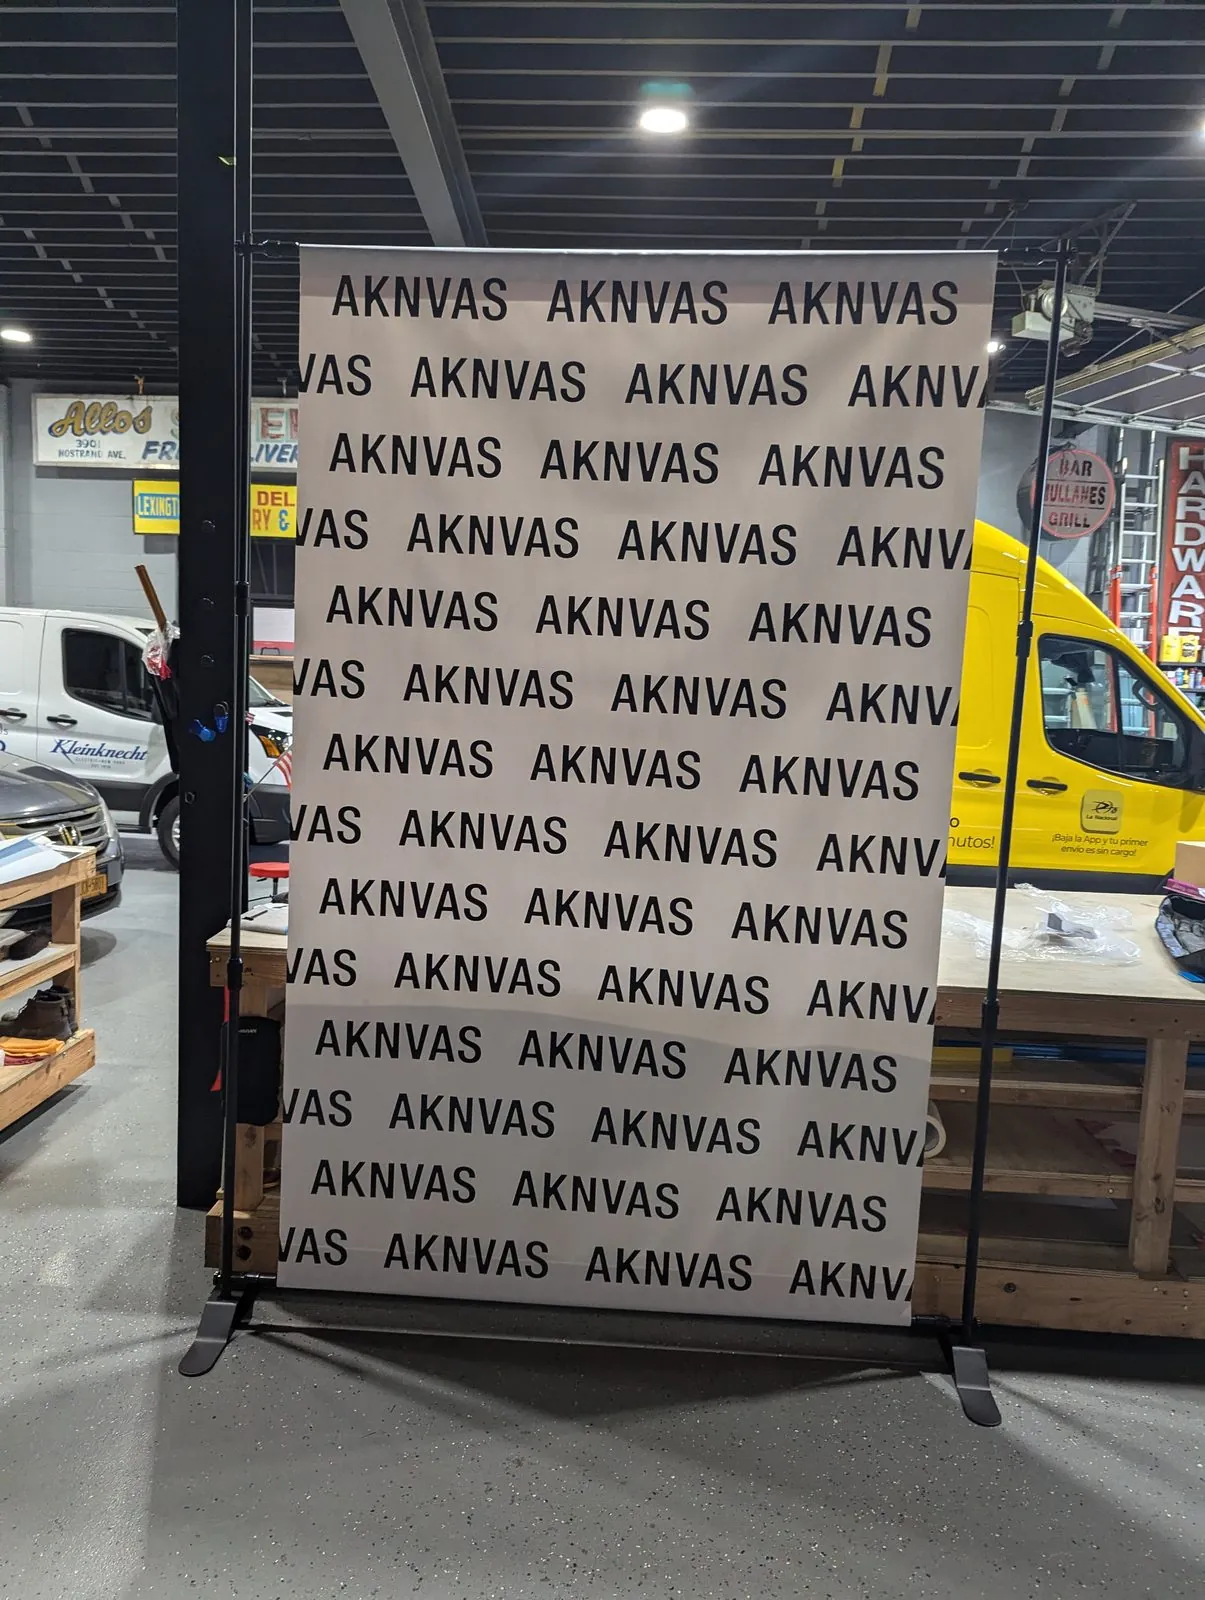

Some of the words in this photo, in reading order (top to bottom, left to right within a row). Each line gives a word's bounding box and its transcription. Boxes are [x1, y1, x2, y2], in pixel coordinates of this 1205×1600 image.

[332, 275, 507, 320] AKNVAS
[547, 280, 727, 324] AKNVAS
[769, 281, 957, 325] AKNVAS
[411, 357, 585, 402] AKNVAS
[625, 364, 807, 405] AKNVAS
[48, 401, 152, 437] Allos
[142, 441, 179, 460] FR
[329, 433, 501, 478] AKNVAS
[540, 440, 718, 484] AKNVAS
[759, 445, 944, 489] AKNVAS
[1060, 459, 1093, 477] BAR
[407, 513, 578, 558] AKNVAS
[618, 520, 796, 565] AKNVAS
[1047, 511, 1091, 528] GRILL
[327, 586, 497, 631] AKNVAS
[536, 595, 709, 640] AKNVAS
[749, 603, 931, 647] AKNVAS
[404, 664, 572, 709] AKNVAS
[611, 674, 786, 719] AKNVAS
[50, 739, 148, 764] Kleinknecht
[323, 734, 492, 778] AKNVAS
[531, 744, 700, 789] AKNVAS
[740, 755, 918, 800] AKNVAS
[399, 810, 566, 854] AKNVAS
[604, 821, 776, 868] AKNVAS
[319, 878, 487, 921] AKNVAS
[524, 888, 692, 935] AKNVAS
[732, 902, 907, 949] AKNVAS
[394, 953, 560, 997] AKNVAS
[598, 966, 768, 1014] AKNVAS
[315, 1020, 481, 1063] AKNVAS
[518, 1030, 686, 1079] AKNVAS
[724, 1048, 896, 1093] AKNVAS
[389, 1093, 554, 1138] AKNVAS
[591, 1107, 760, 1154] AKNVAS
[311, 1160, 475, 1203] AKNVAS
[512, 1171, 678, 1219] AKNVAS
[716, 1187, 886, 1232] AKNVAS
[384, 1233, 548, 1278] AKNVAS
[585, 1247, 752, 1291] AKNVAS
